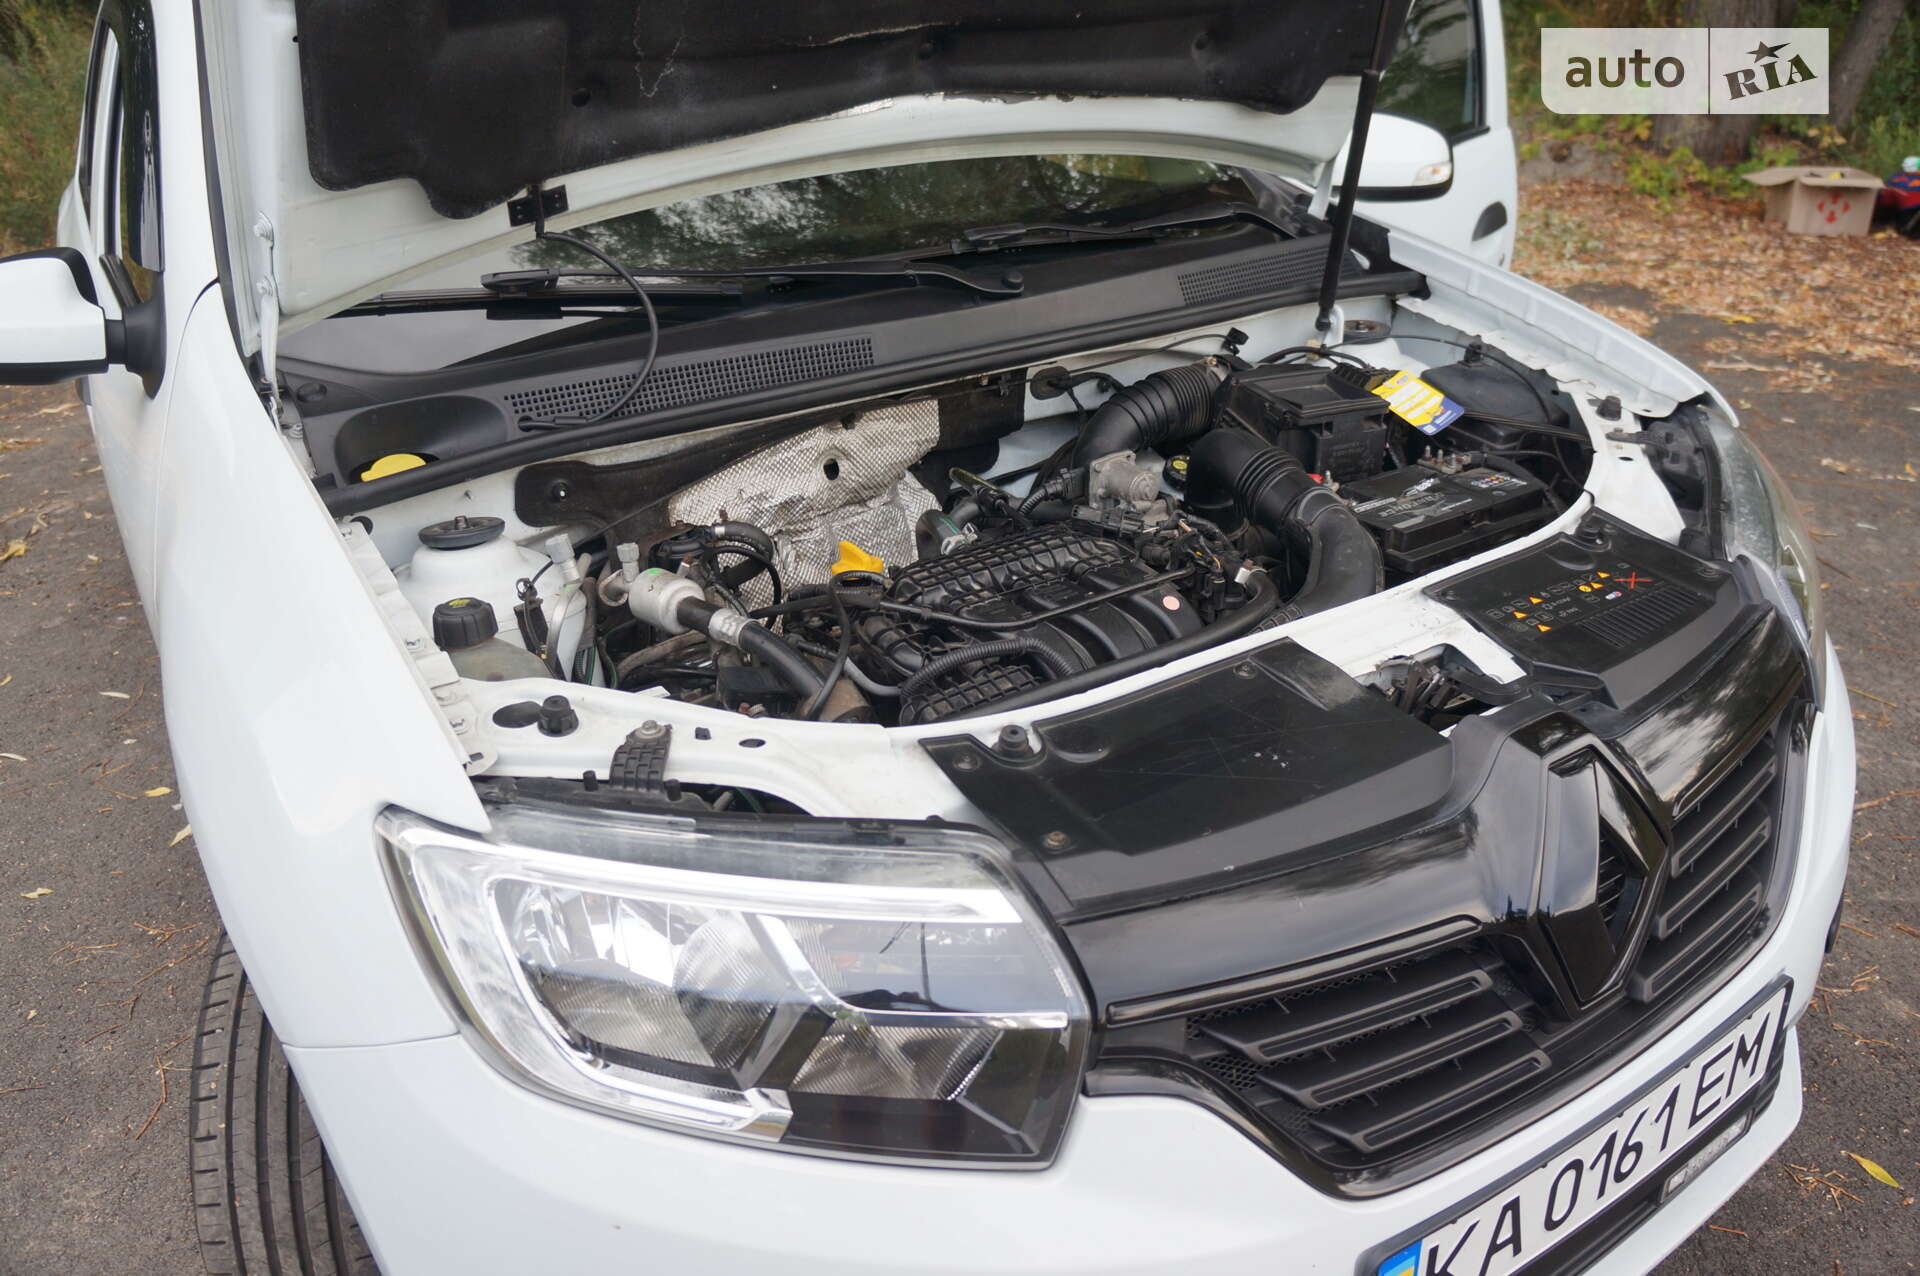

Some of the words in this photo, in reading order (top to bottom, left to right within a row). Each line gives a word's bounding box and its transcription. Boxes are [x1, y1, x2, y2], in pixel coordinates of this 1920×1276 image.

[1425, 1195, 1523, 1276] KA
[1544, 1083, 1680, 1232] 0161
[1688, 1012, 1772, 1130] EM
